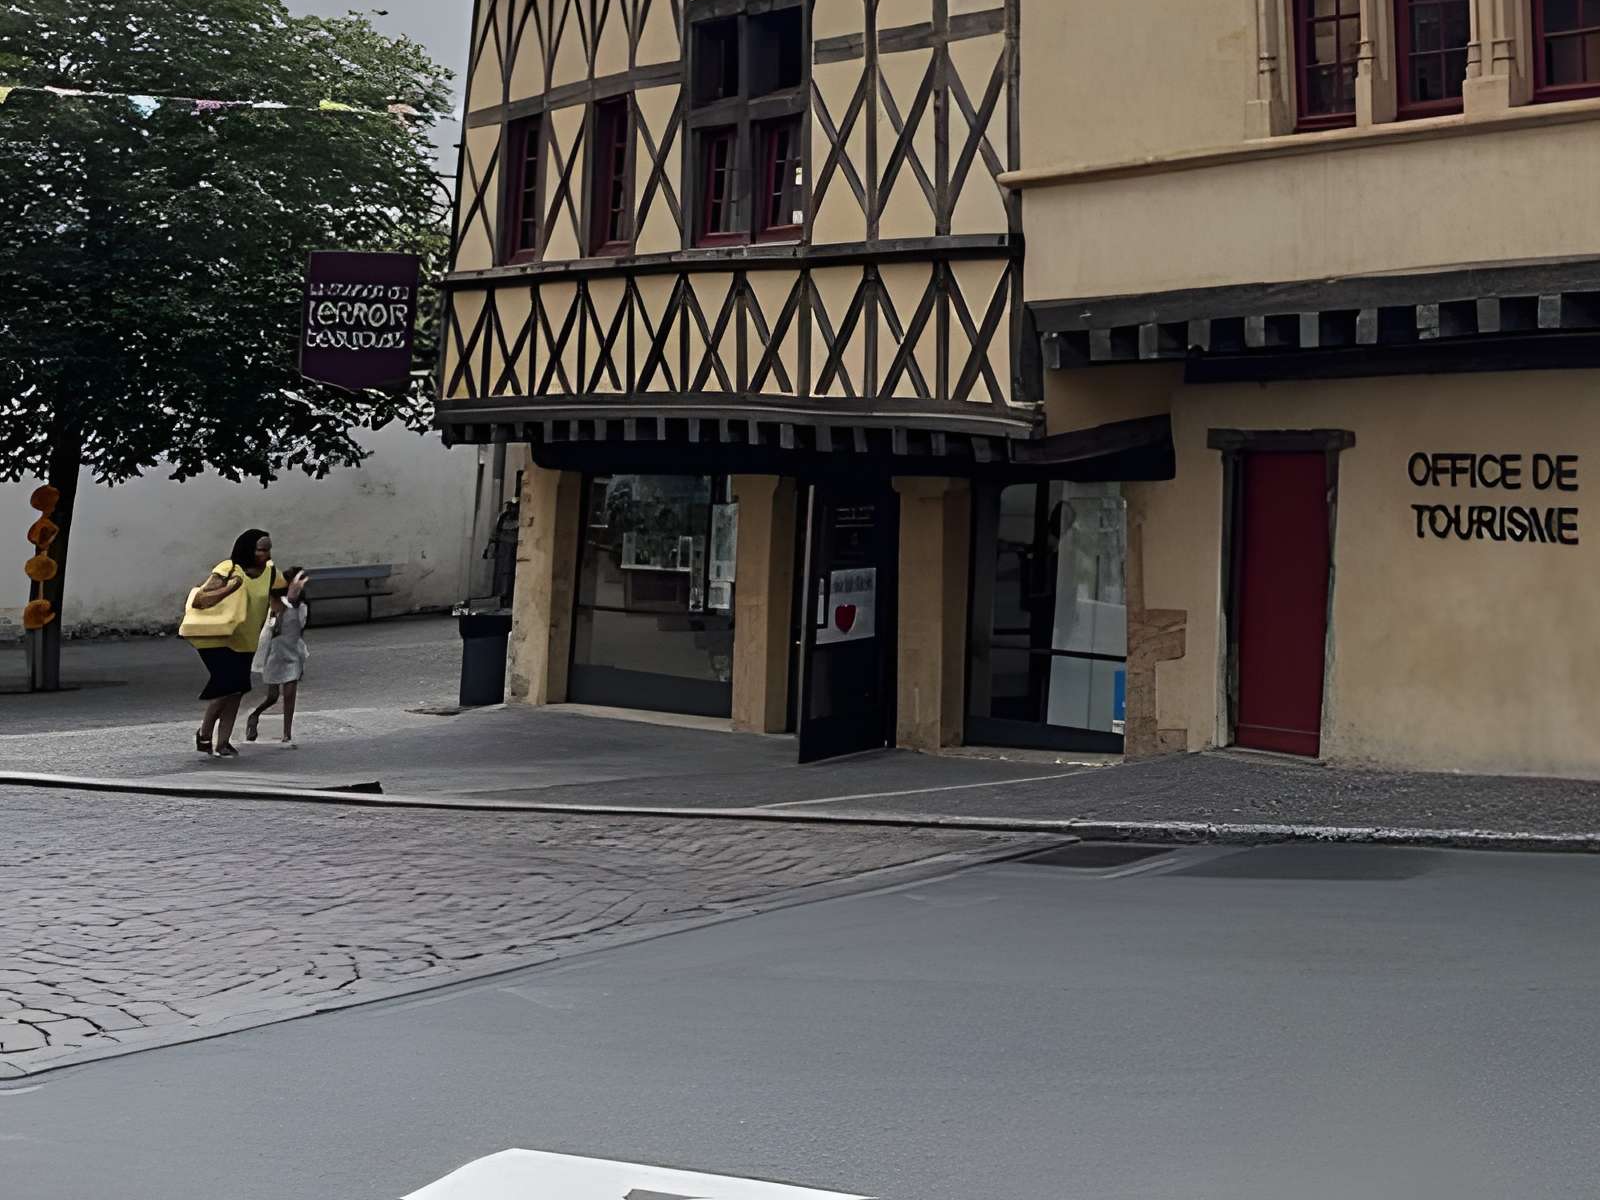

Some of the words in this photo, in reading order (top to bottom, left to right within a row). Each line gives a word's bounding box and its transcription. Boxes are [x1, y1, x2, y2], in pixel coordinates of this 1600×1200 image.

[1408, 452, 1521, 490] OFFICE
[1532, 453, 1578, 491] DE
[1411, 504, 1578, 545] TOURISME
